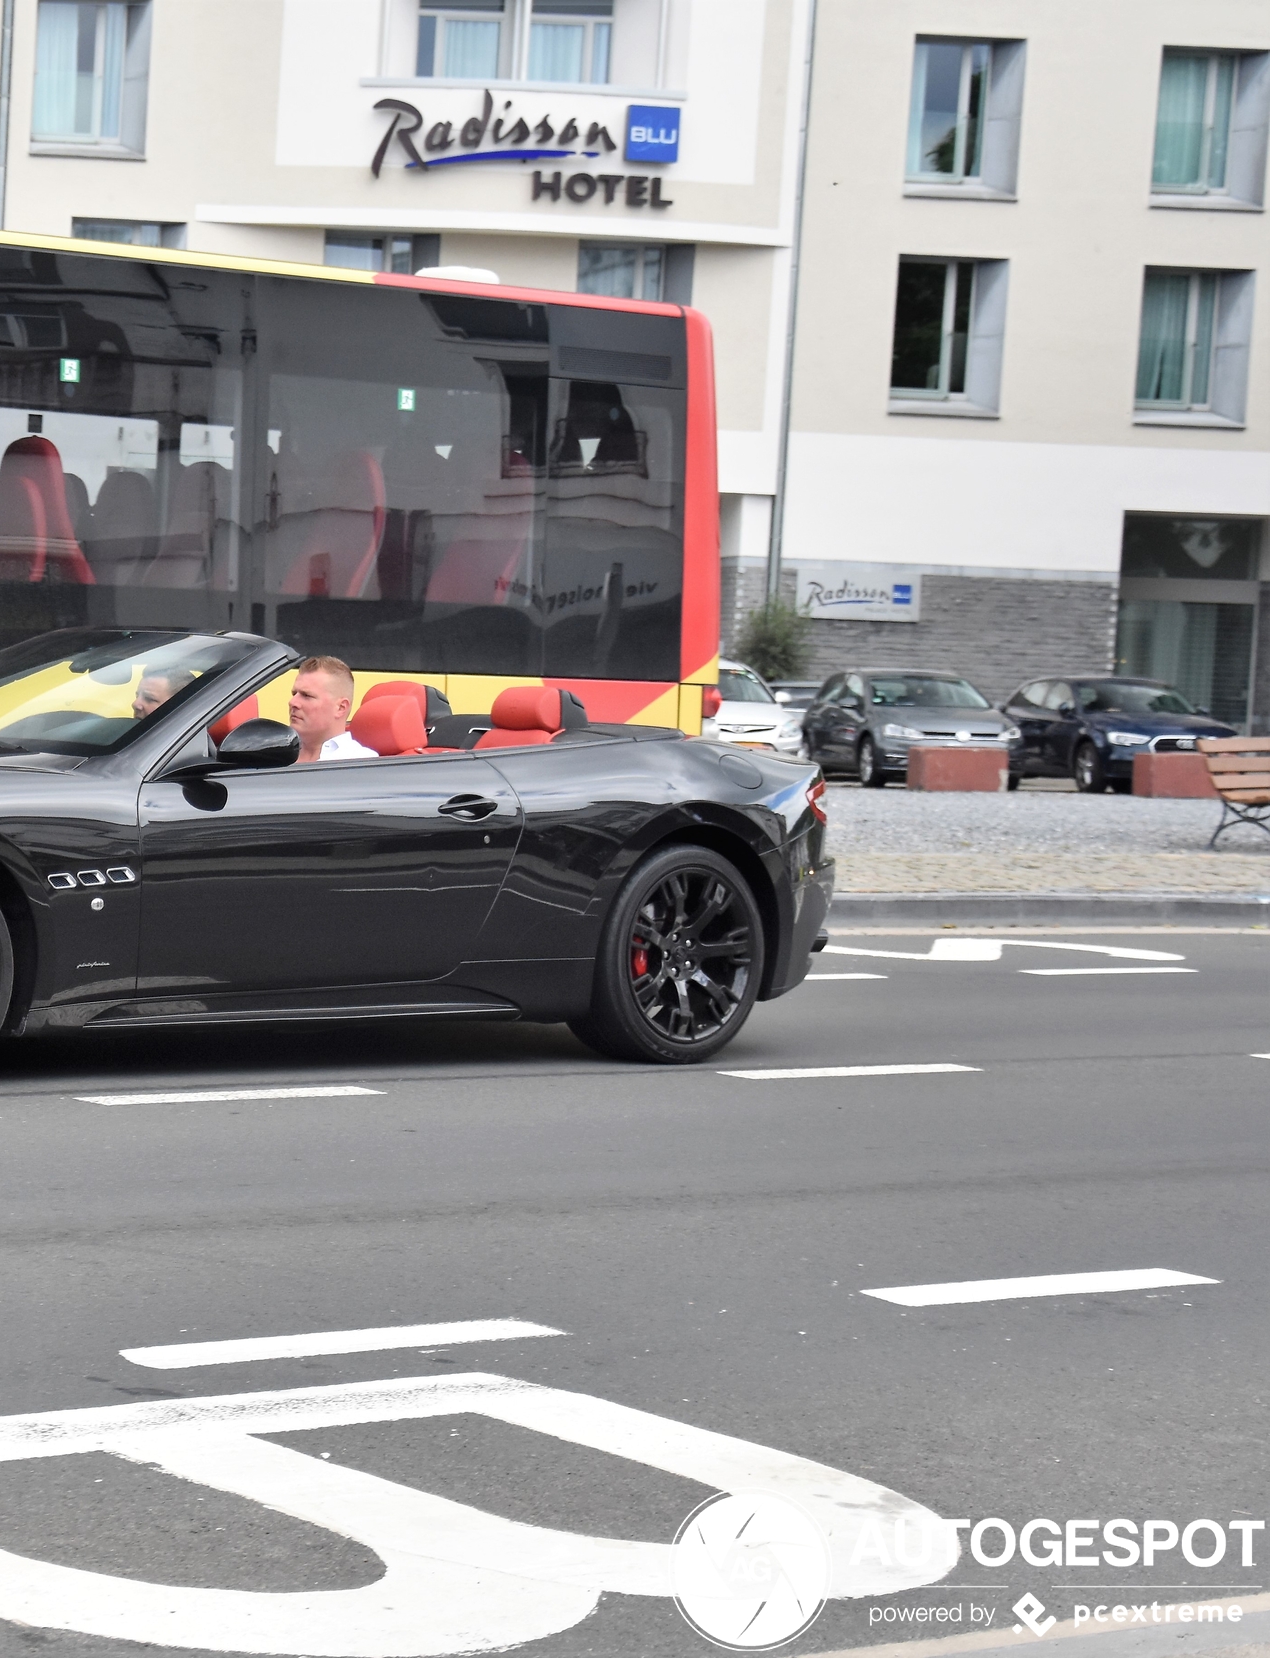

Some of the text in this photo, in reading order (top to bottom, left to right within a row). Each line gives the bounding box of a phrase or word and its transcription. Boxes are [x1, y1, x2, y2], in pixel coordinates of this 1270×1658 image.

[371, 88, 678, 178] Radisson BLU
[531, 170, 674, 208] HOTEL
[805, 579, 891, 607] Radisson
